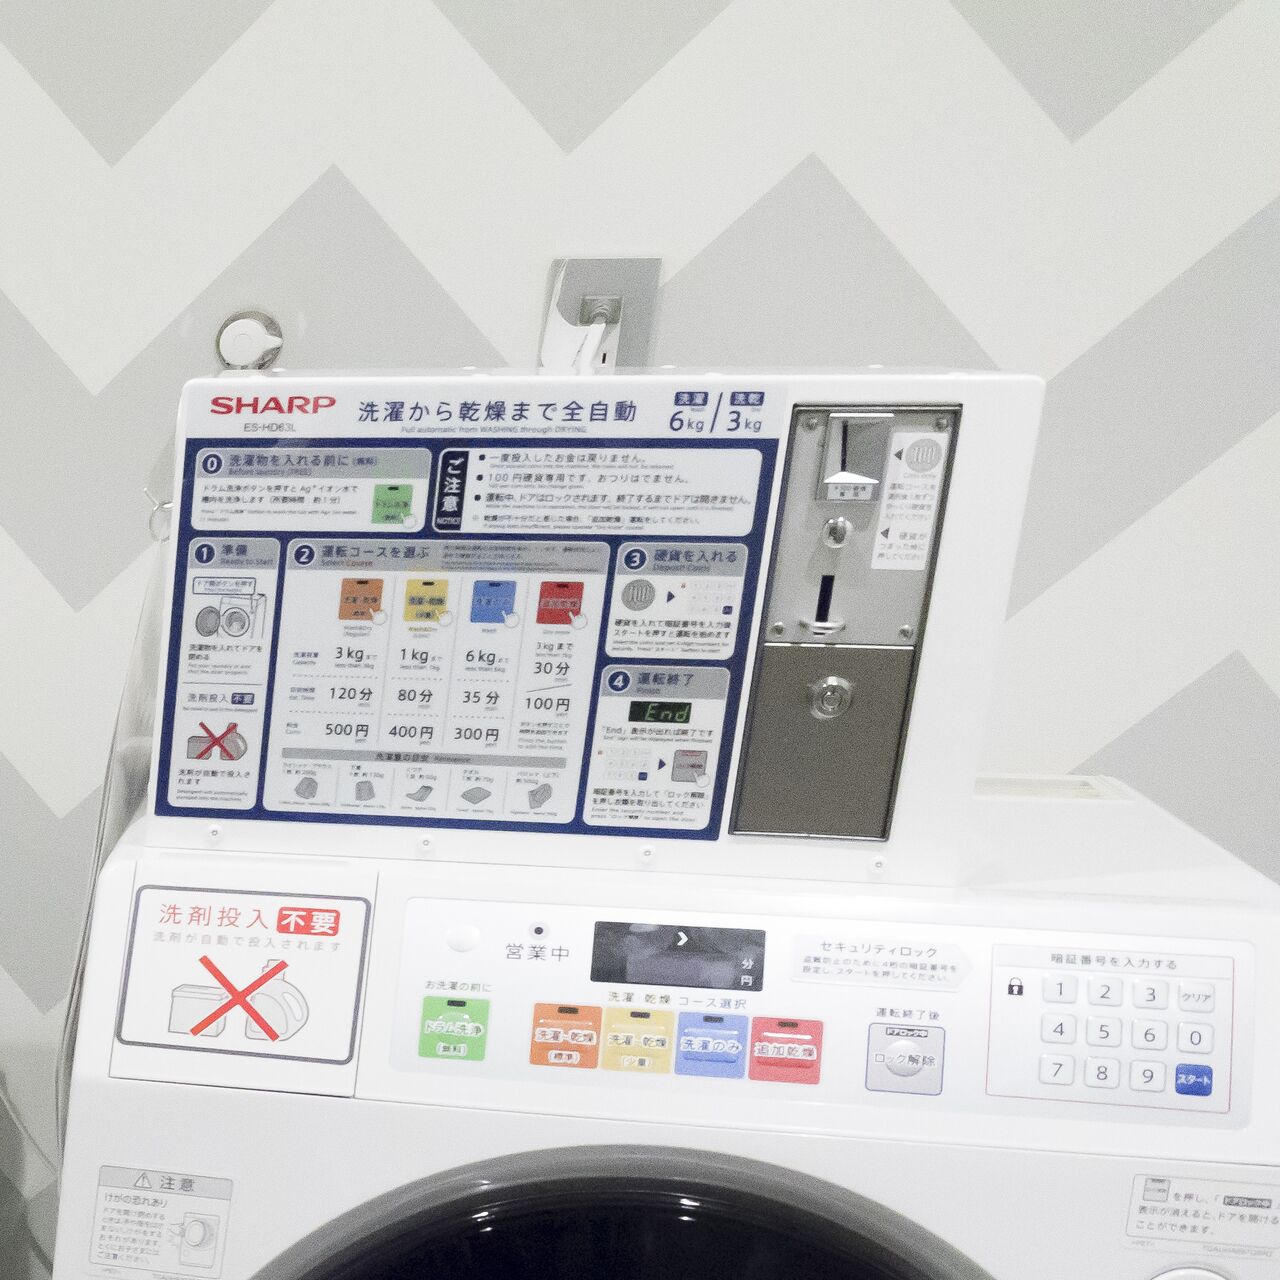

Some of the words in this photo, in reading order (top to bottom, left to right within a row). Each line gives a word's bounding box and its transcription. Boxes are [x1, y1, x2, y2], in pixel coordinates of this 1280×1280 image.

[210, 395, 337, 415] SHARP
[358, 400, 637, 423] 洗濯から乾燥まで全自動
[243, 423, 296, 432] ES-HD63L
[229, 454, 349, 467] 洗濯物を入れる前に
[489, 453, 647, 464] 一度投入したお金は戻りません。
[444, 457, 465, 513] ご注意
[221, 544, 248, 556] 準備
[321, 545, 430, 559] 運転コースを選ぶ
[653, 549, 738, 564] 硬貨を入れる
[637, 672, 694, 686] 運転終了
[645, 703, 689, 722] End
[159, 903, 269, 929] 洗剤投入
[279, 910, 338, 935] 不要
[152, 931, 342, 952] 洗剤が自動で投入されます
[820, 940, 938, 958] セキュリティロック
[505, 943, 570, 962] 営業中
[741, 958, 753, 970] 分
[1050, 952, 1178, 971] 暗証番号を入力する
[425, 979, 492, 993] お洗濯の前に
[741, 975, 753, 987] 円
[678, 995, 748, 1010] コース選択
[1100, 985, 1111, 1000] 2
[1145, 987, 1157, 1002] 3
[1181, 992, 1212, 1004] クリア
[876, 1006, 941, 1021] 運転終了後
[1053, 1021, 1065, 1037] 4
[1099, 1024, 1110, 1040] 5
[1143, 1027, 1156, 1043] 6
[681, 1037, 742, 1053] 洗濯のみ
[755, 1042, 816, 1058] 追加乾燥
[874, 1051, 937, 1068] ロック解除
[1052, 1062, 1063, 1078] 7
[1096, 1065, 1108, 1081] 8
[1142, 1068, 1154, 1084] 9
[1176, 1072, 1212, 1087] スタート
[1135, 1219, 1215, 1236] ことができます。
